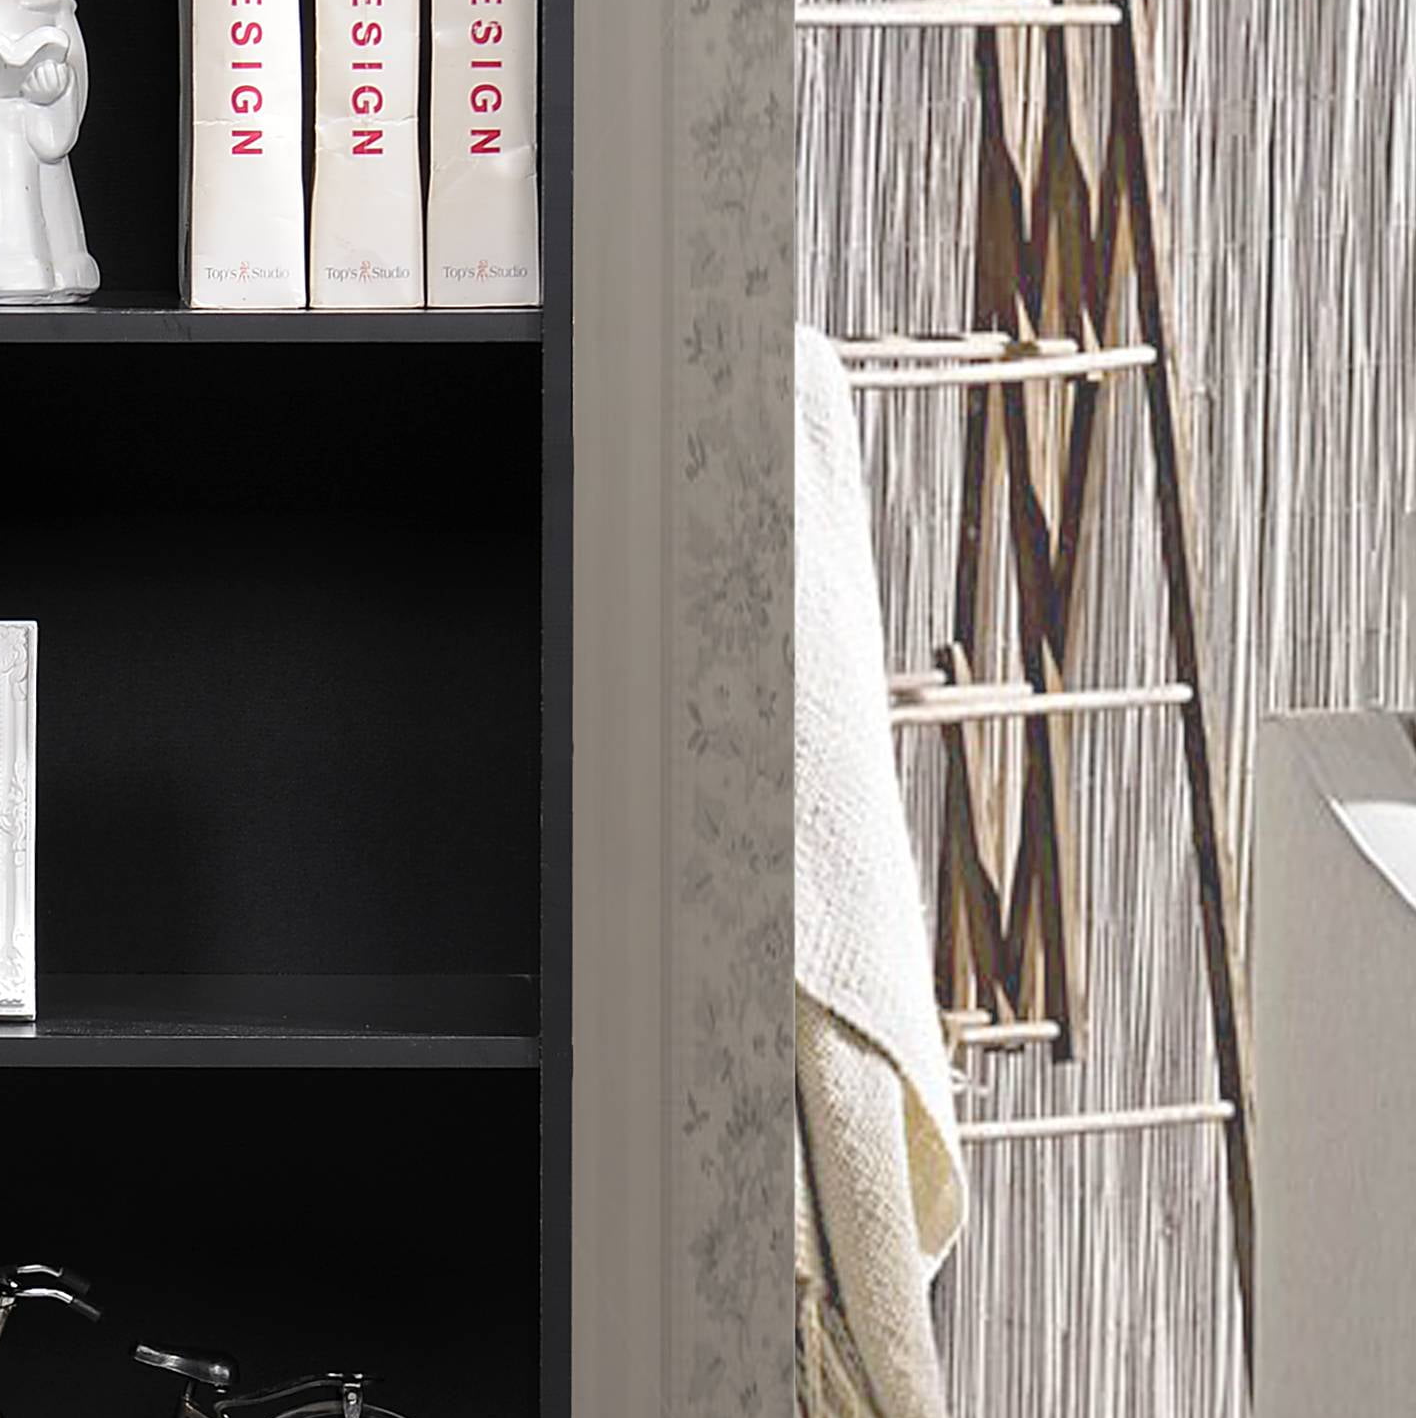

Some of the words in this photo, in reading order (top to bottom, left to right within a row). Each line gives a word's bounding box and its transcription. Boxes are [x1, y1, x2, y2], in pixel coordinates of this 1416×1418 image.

[204, 267, 237, 282] Top's
[251, 266, 290, 279] Studio
[325, 267, 358, 282] Top's
[371, 265, 410, 279] Studio
[443, 265, 475, 281] Top's
[488, 264, 528, 278] Studio
